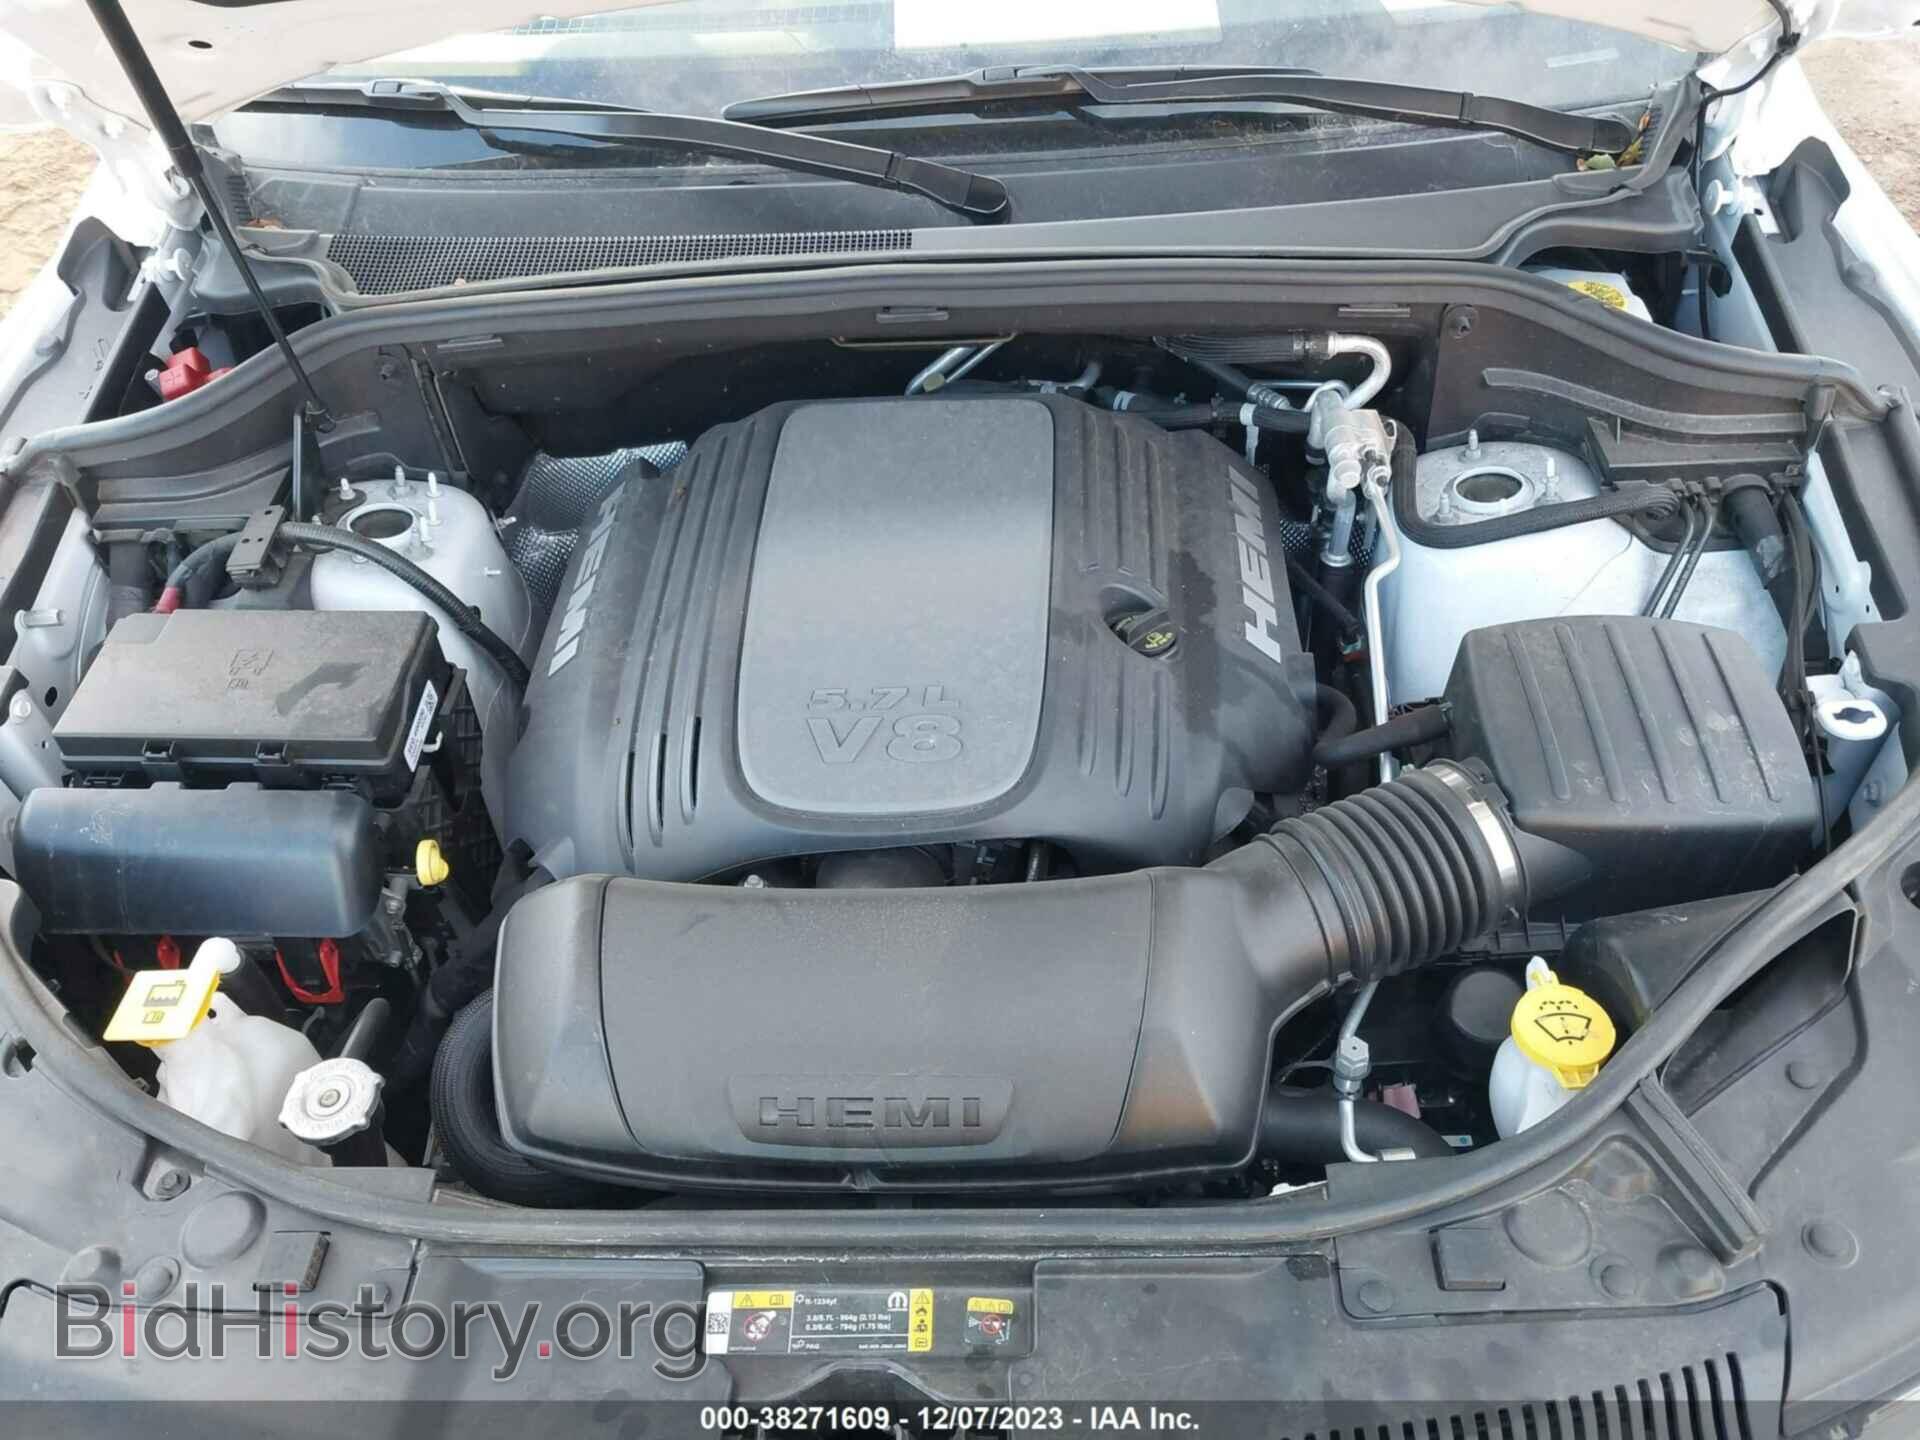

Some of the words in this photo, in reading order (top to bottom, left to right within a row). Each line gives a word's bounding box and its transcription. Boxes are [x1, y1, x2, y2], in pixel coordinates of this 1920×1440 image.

[1228, 464, 1281, 663] HEMI
[805, 713, 964, 765] V8
[759, 1096, 980, 1128] HEMI
